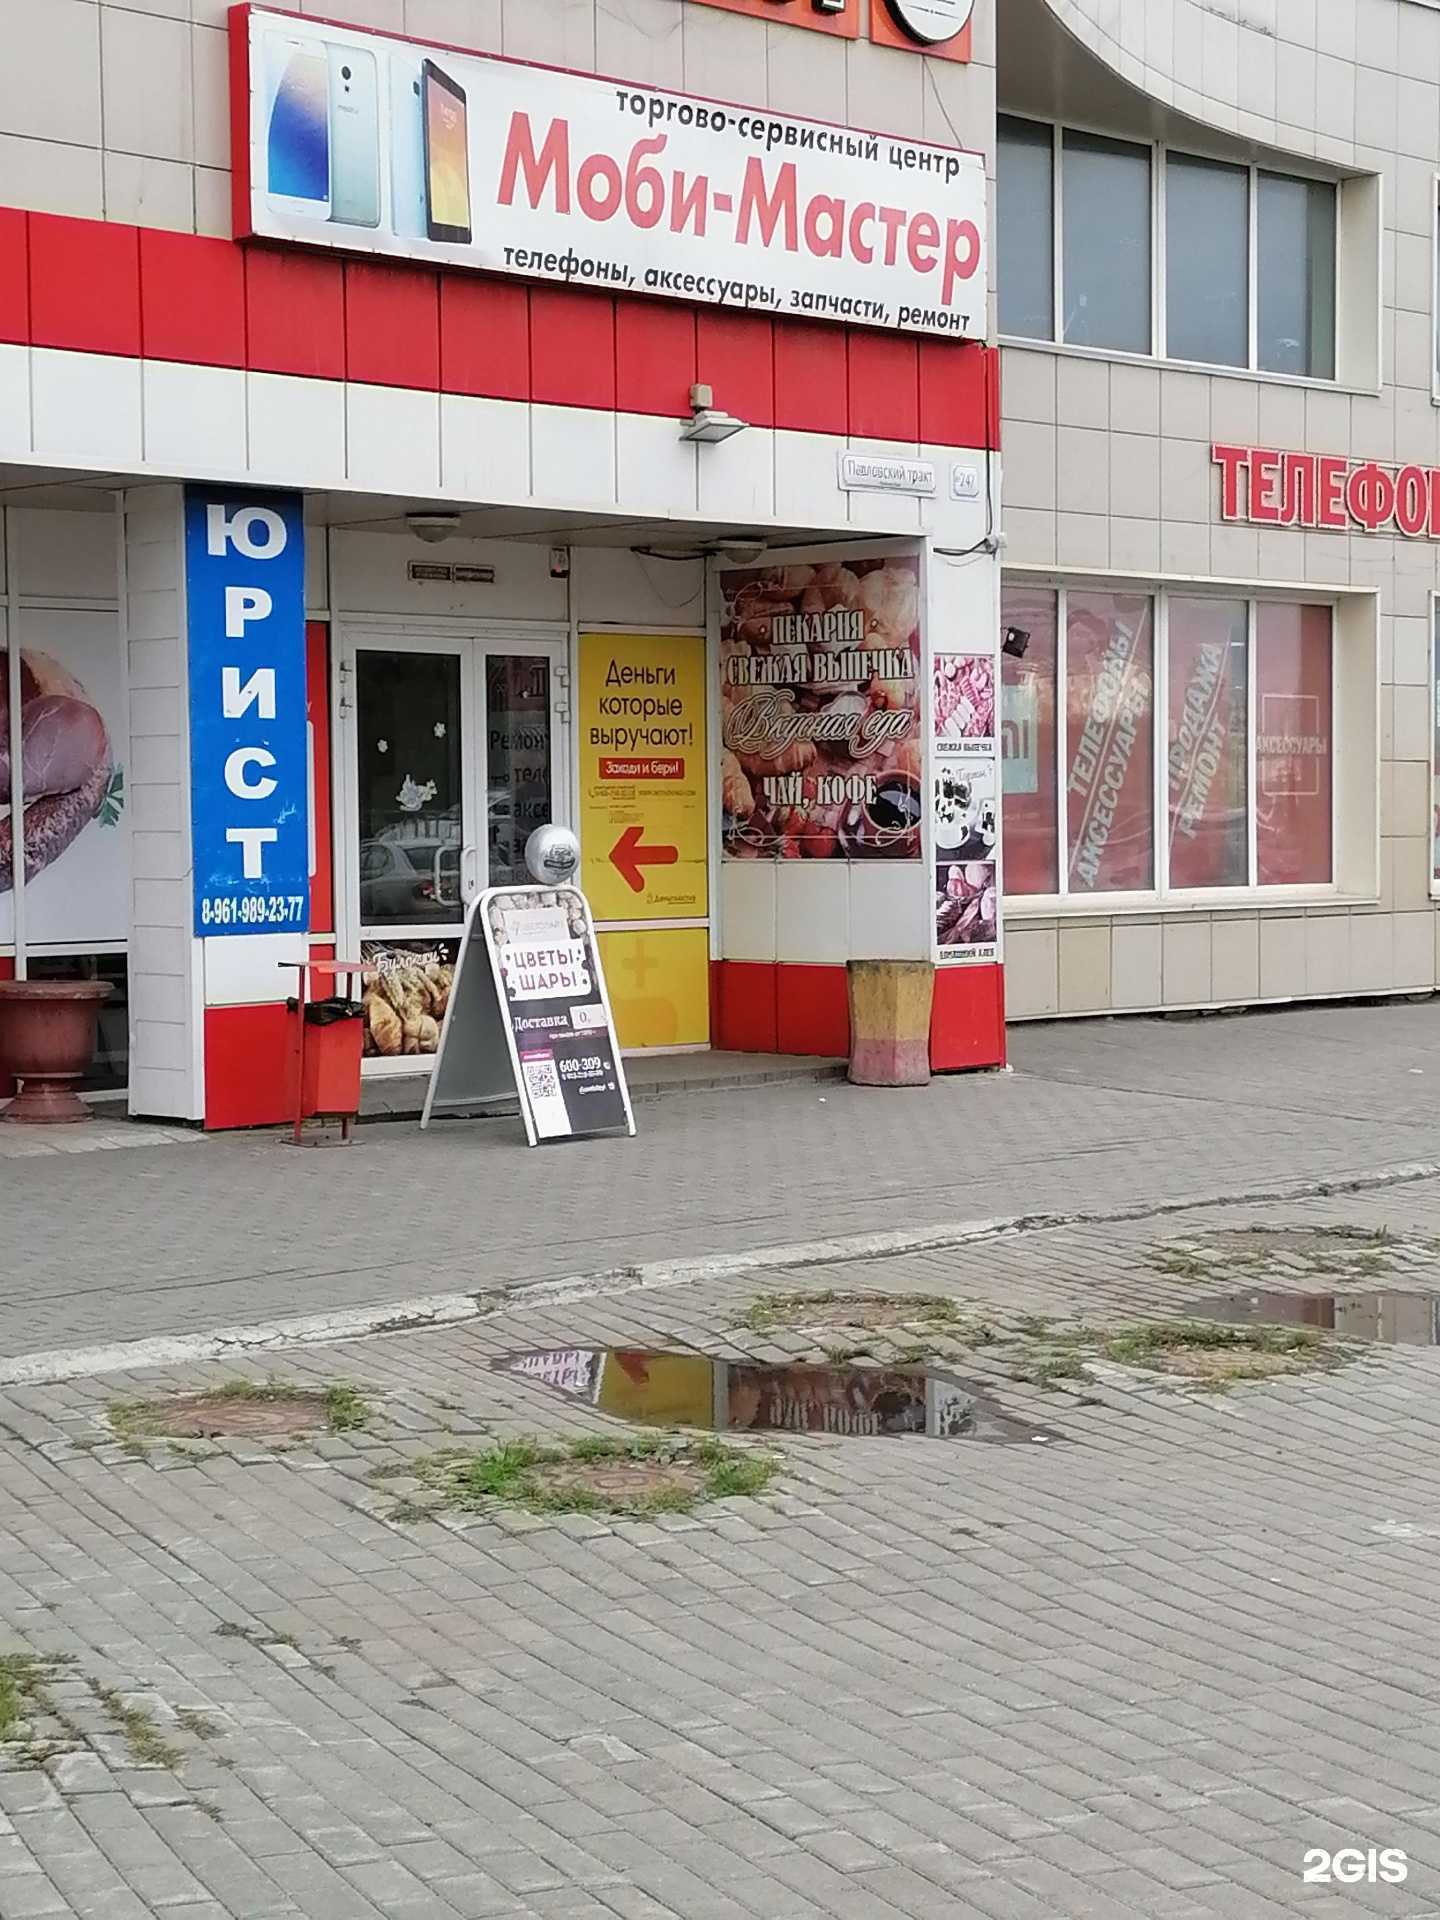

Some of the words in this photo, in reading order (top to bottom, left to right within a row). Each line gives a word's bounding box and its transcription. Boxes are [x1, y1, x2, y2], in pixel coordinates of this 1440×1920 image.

[616, 90, 879, 163] торгово-сервисный
[888, 145, 960, 178] центр
[498, 111, 981, 305] Моби-Мастер
[503, 245, 637, 287] телефоны,
[644, 264, 783, 308] аксессуары,
[790, 288, 890, 324] запчасти,
[898, 304, 971, 331] ремонт
[908, 468, 933, 485] тракт
[771, 609, 864, 645] ПЕКАРНЯ
[605, 659, 676, 688] Деньги
[727, 653, 808, 686] СВЕЖАЯ
[813, 647, 915, 683] ВЫПЕЧКА
[206, 504, 288, 880] ЮРИСТ
[600, 696, 683, 722] которые
[590, 723, 693, 751] выручают!
[816, 774, 878, 806] КОФЕ
[514, 948, 574, 970] ЦВЕТЫ
[519, 972, 577, 991] ШАРЫ
[513, 1012, 569, 1033] Доставка
[559, 1056, 601, 1073] 600-309
